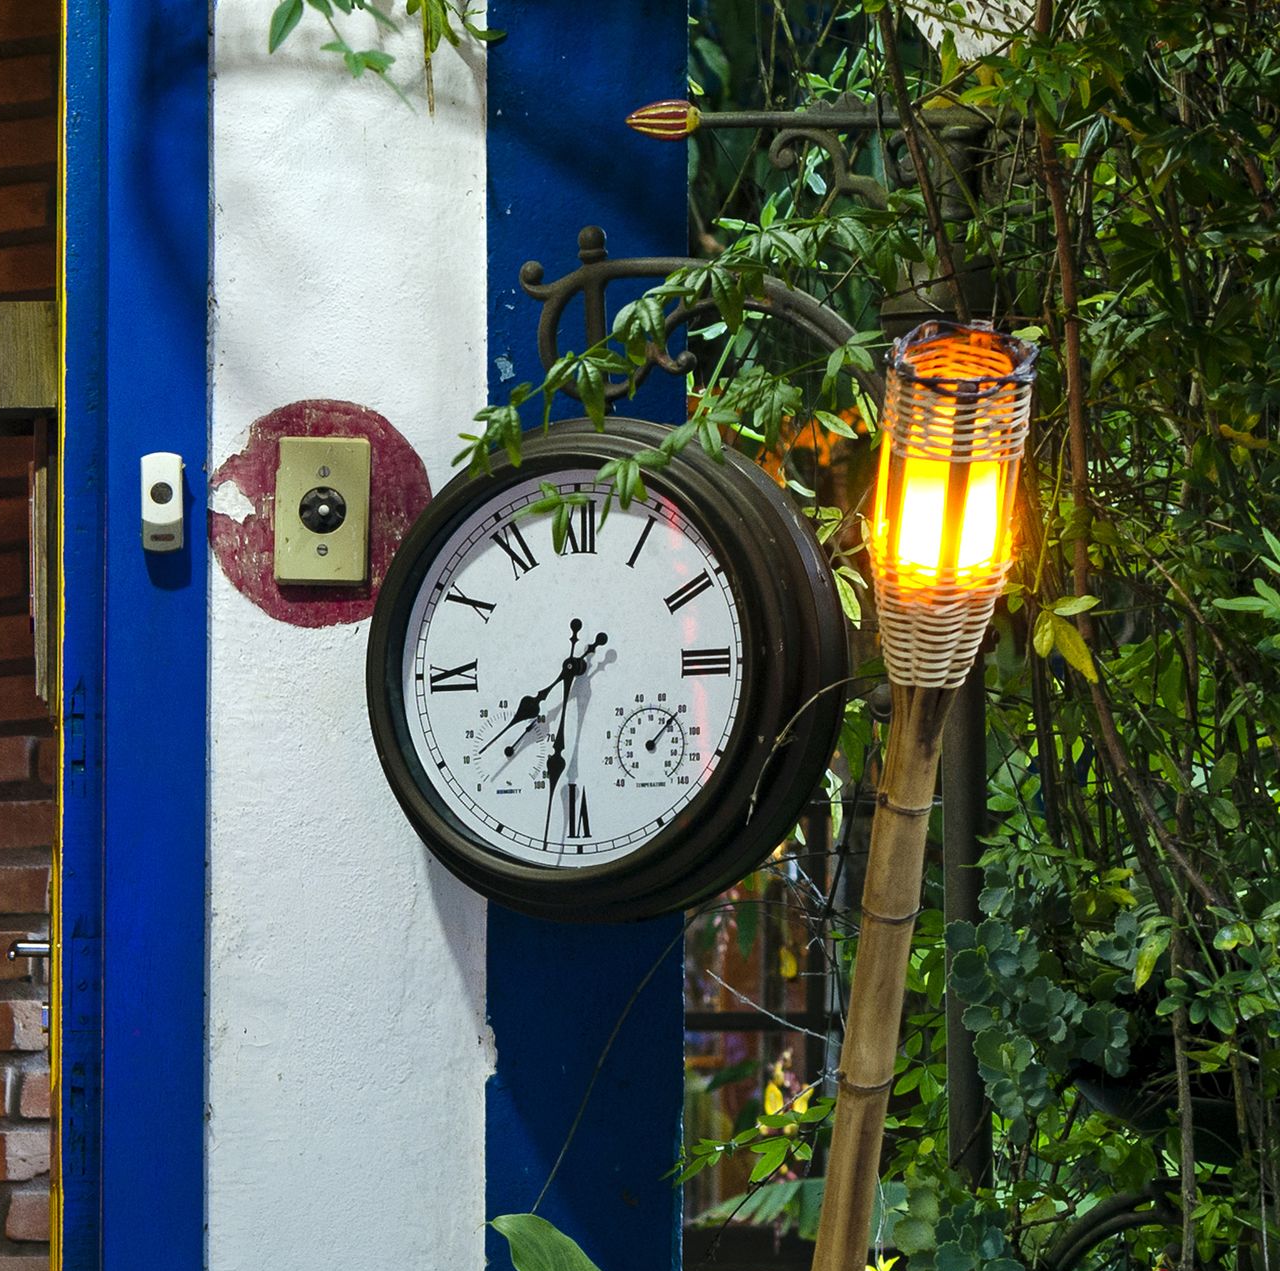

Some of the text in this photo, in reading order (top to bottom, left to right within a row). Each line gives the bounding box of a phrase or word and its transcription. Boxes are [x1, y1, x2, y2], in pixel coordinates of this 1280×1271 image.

[558, 499, 598, 556] XII
[625, 514, 658, 569] I
[489, 519, 540, 581] XI
[663, 567, 715, 615] II
[444, 581, 497, 624] X
[681, 645, 731, 679] III
[430, 658, 479, 694] IX
[635, 694, 645, 703] 40
[657, 693, 667, 702] 60
[499, 700, 508, 709] 40
[479, 709, 488, 719] 30
[615, 707, 624, 717] 20
[465, 730, 474, 739] 20
[606, 730, 611, 739] 0
[689, 726, 700, 735] 100
[463, 755, 470, 764] 10
[689, 753, 700, 761] 120
[534, 780, 545, 789] 100
[677, 776, 689, 785] 140
[477, 783, 482, 792] 0
[567, 783, 592, 839] VI
